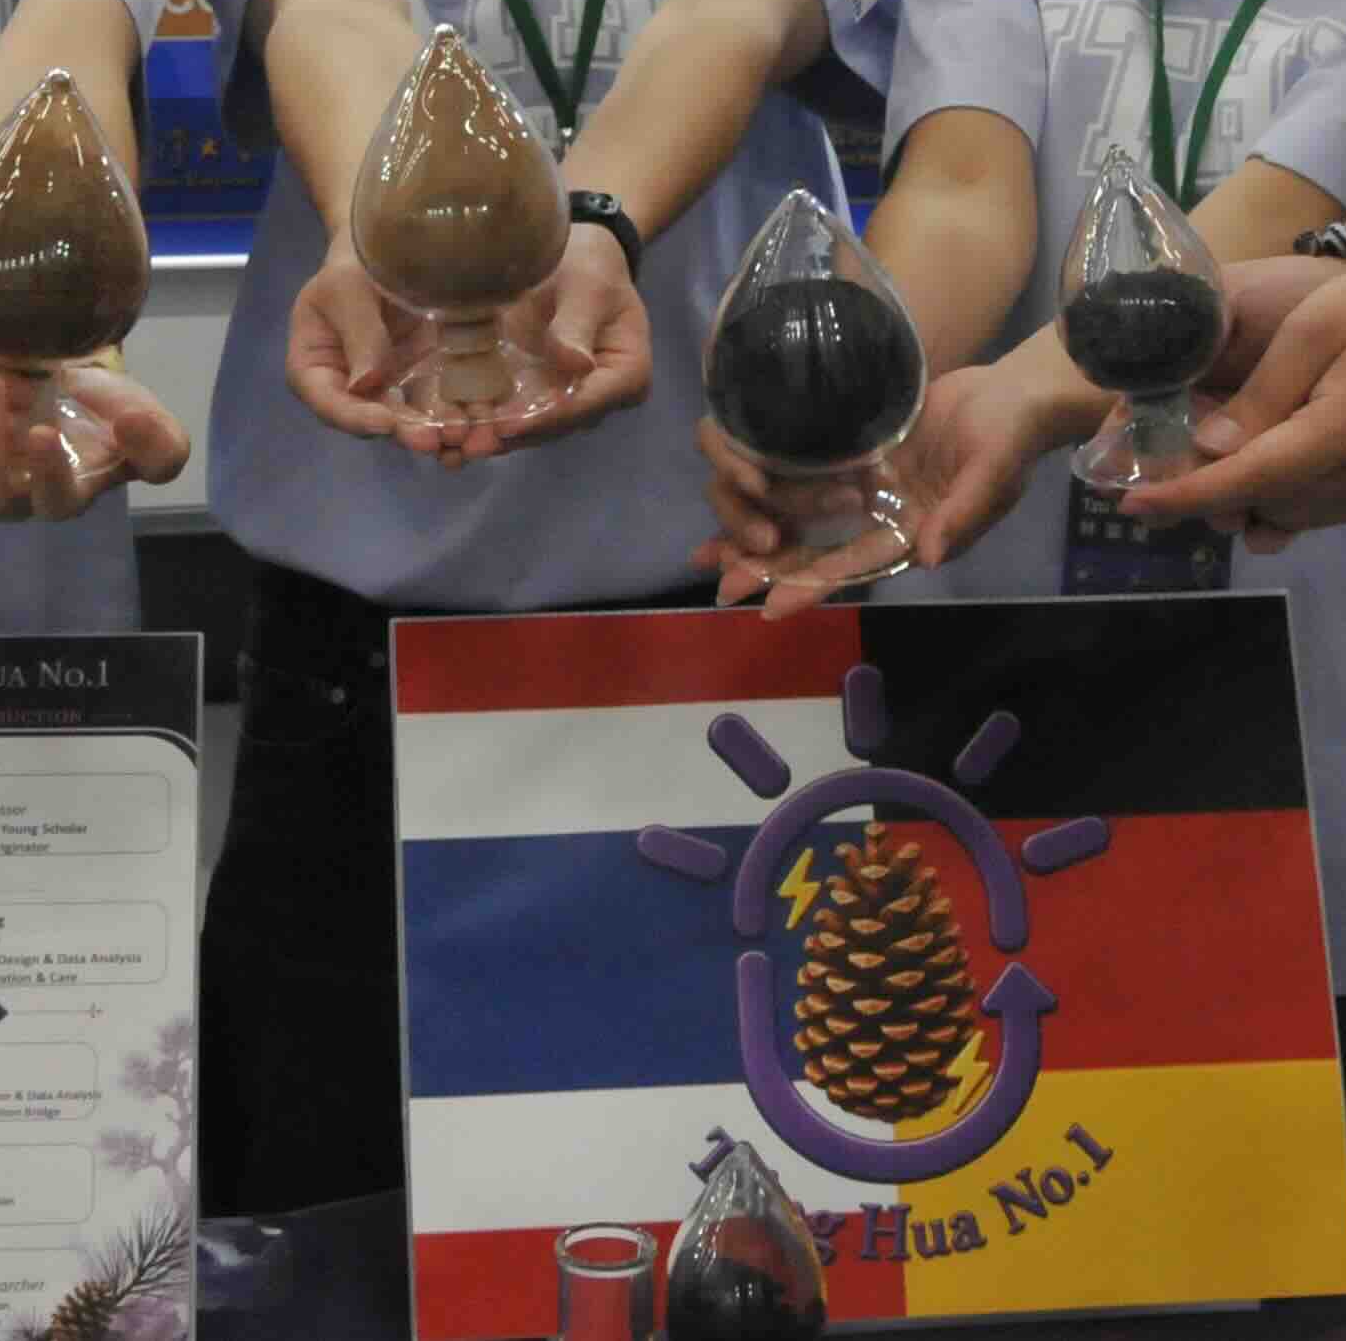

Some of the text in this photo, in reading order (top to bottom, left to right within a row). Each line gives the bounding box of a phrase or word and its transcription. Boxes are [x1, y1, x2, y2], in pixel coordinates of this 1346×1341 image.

[1, 822, 88, 837] Young Scholar
[89, 953, 142, 967] Analysis
[859, 1122, 1115, 1264] Hua No.1
